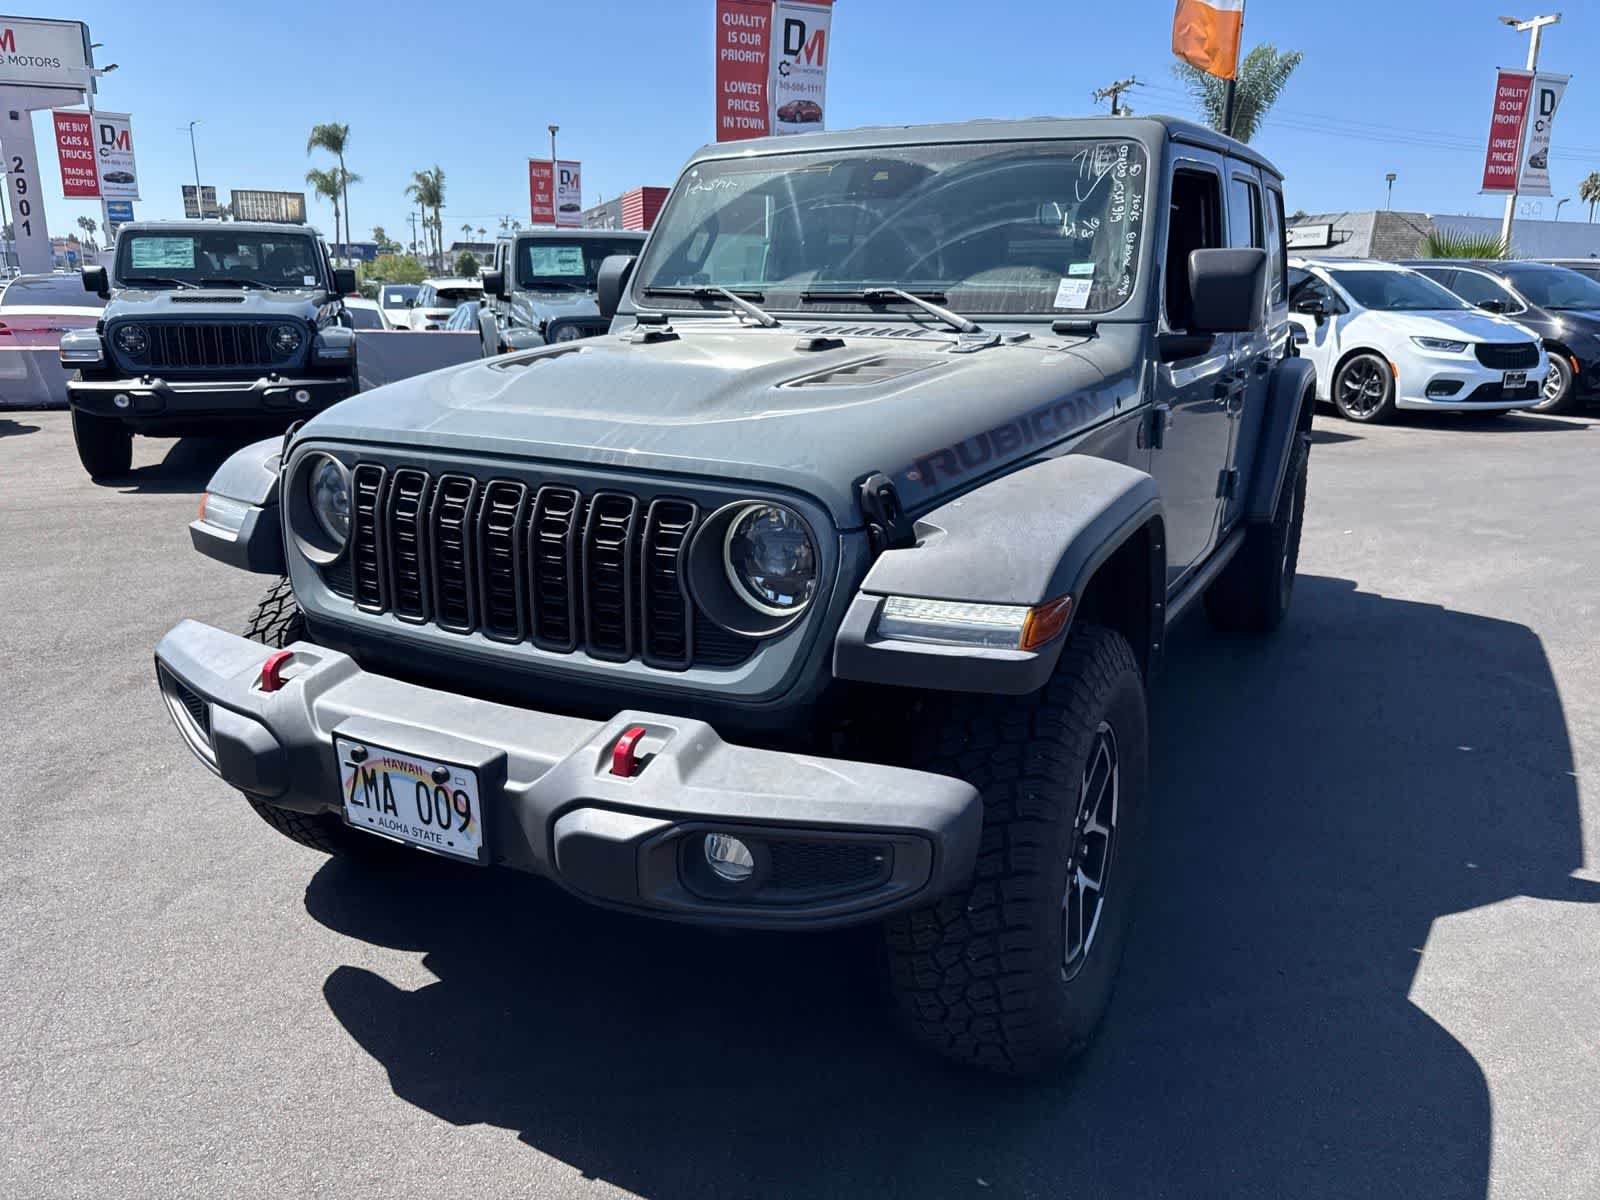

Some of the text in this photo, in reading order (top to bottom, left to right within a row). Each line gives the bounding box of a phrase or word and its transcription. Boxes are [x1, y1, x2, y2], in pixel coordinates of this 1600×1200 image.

[722, 13, 766, 28] QUALITY
[728, 31, 761, 45] IS OUR
[784, 18, 825, 67] DM
[8, 55, 61, 68] MOTORS
[721, 48, 765, 64] PRIORITY
[724, 81, 762, 95] LOWEST
[1499, 87, 1529, 97] QUALITY
[727, 98, 760, 112] PRICES
[58, 122, 88, 132] WE BUY
[723, 116, 765, 129] IN TOWN
[61, 136, 89, 146] CARS &
[61, 150, 92, 160] TRUCKS
[64, 168, 93, 177] TRADE-IN
[64, 179, 96, 188] ACCEPTED
[383, 756, 423, 776] HAWAII
[343, 760, 471, 833] ZMA 009
[378, 817, 442, 844] ALOHA STATE
